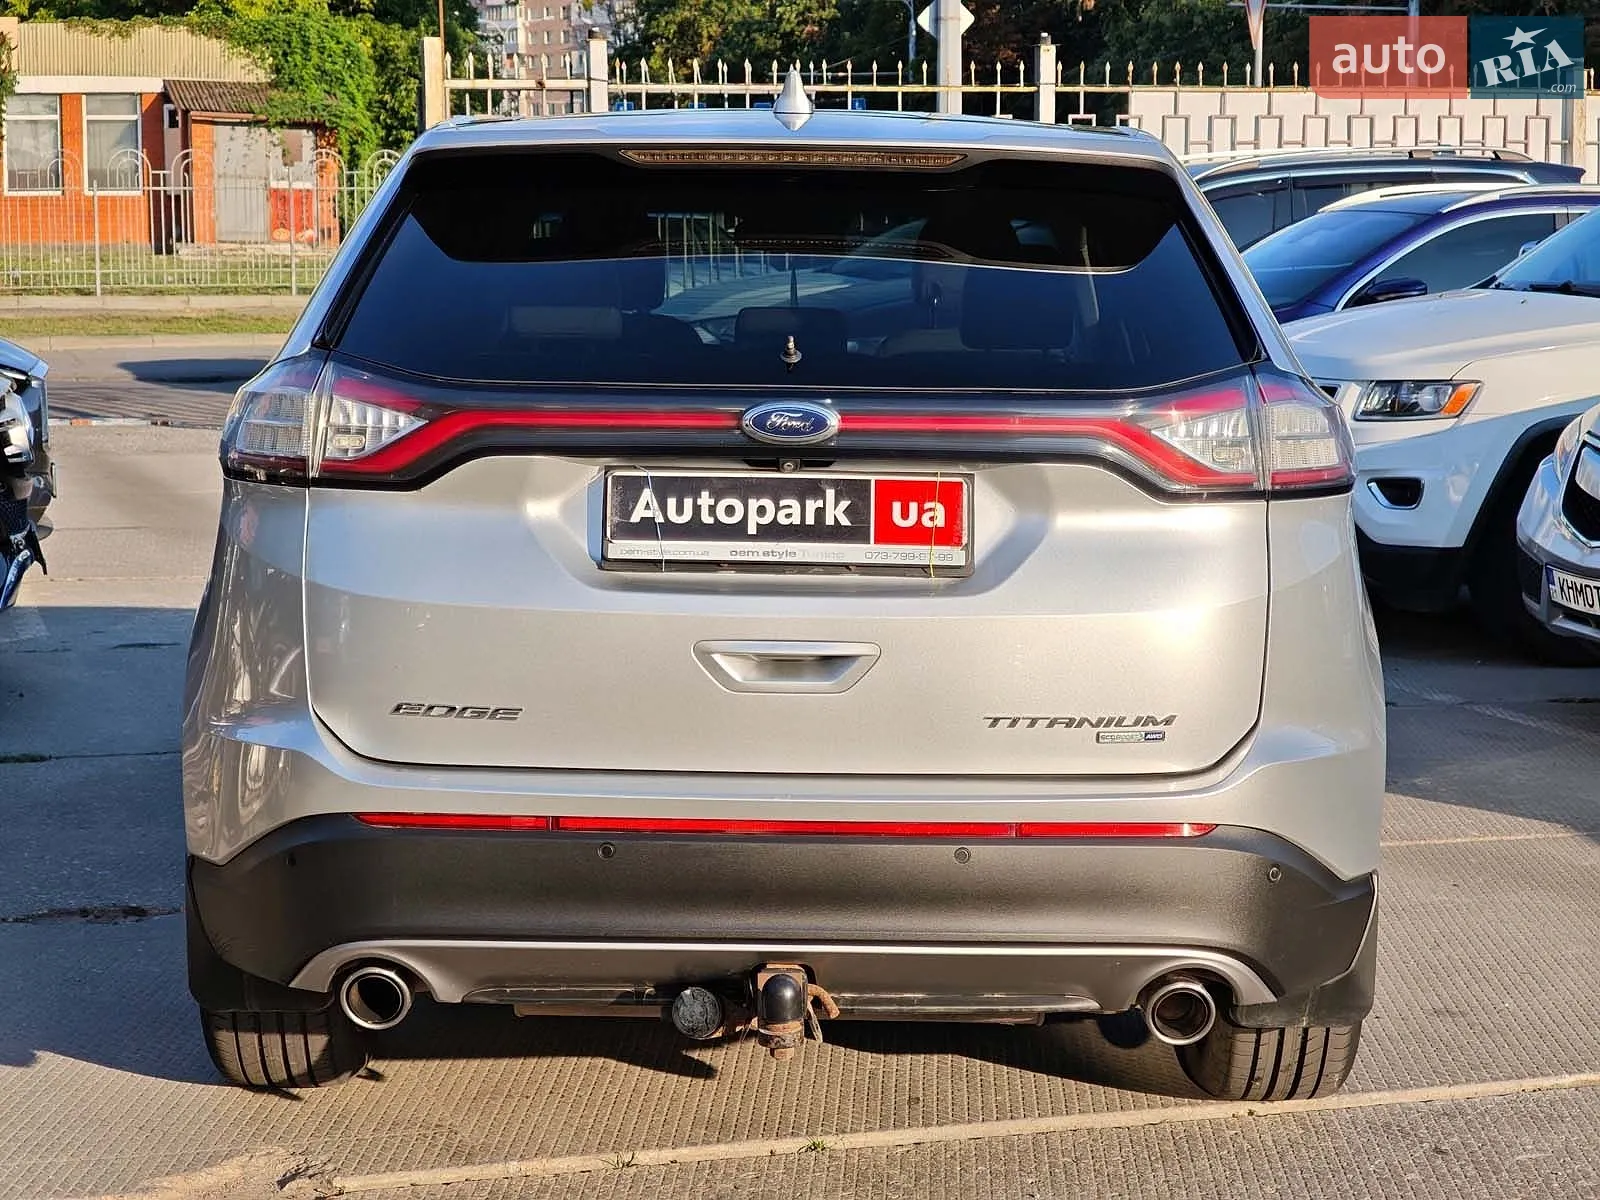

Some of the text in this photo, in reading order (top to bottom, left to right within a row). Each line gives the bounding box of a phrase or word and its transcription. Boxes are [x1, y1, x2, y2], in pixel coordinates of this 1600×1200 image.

[767, 411, 815, 432] Ford
[630, 488, 946, 535] Autopark ua
[762, 549, 797, 559] style
[391, 702, 523, 720] EDGE
[983, 714, 1178, 729] TITANIUM
